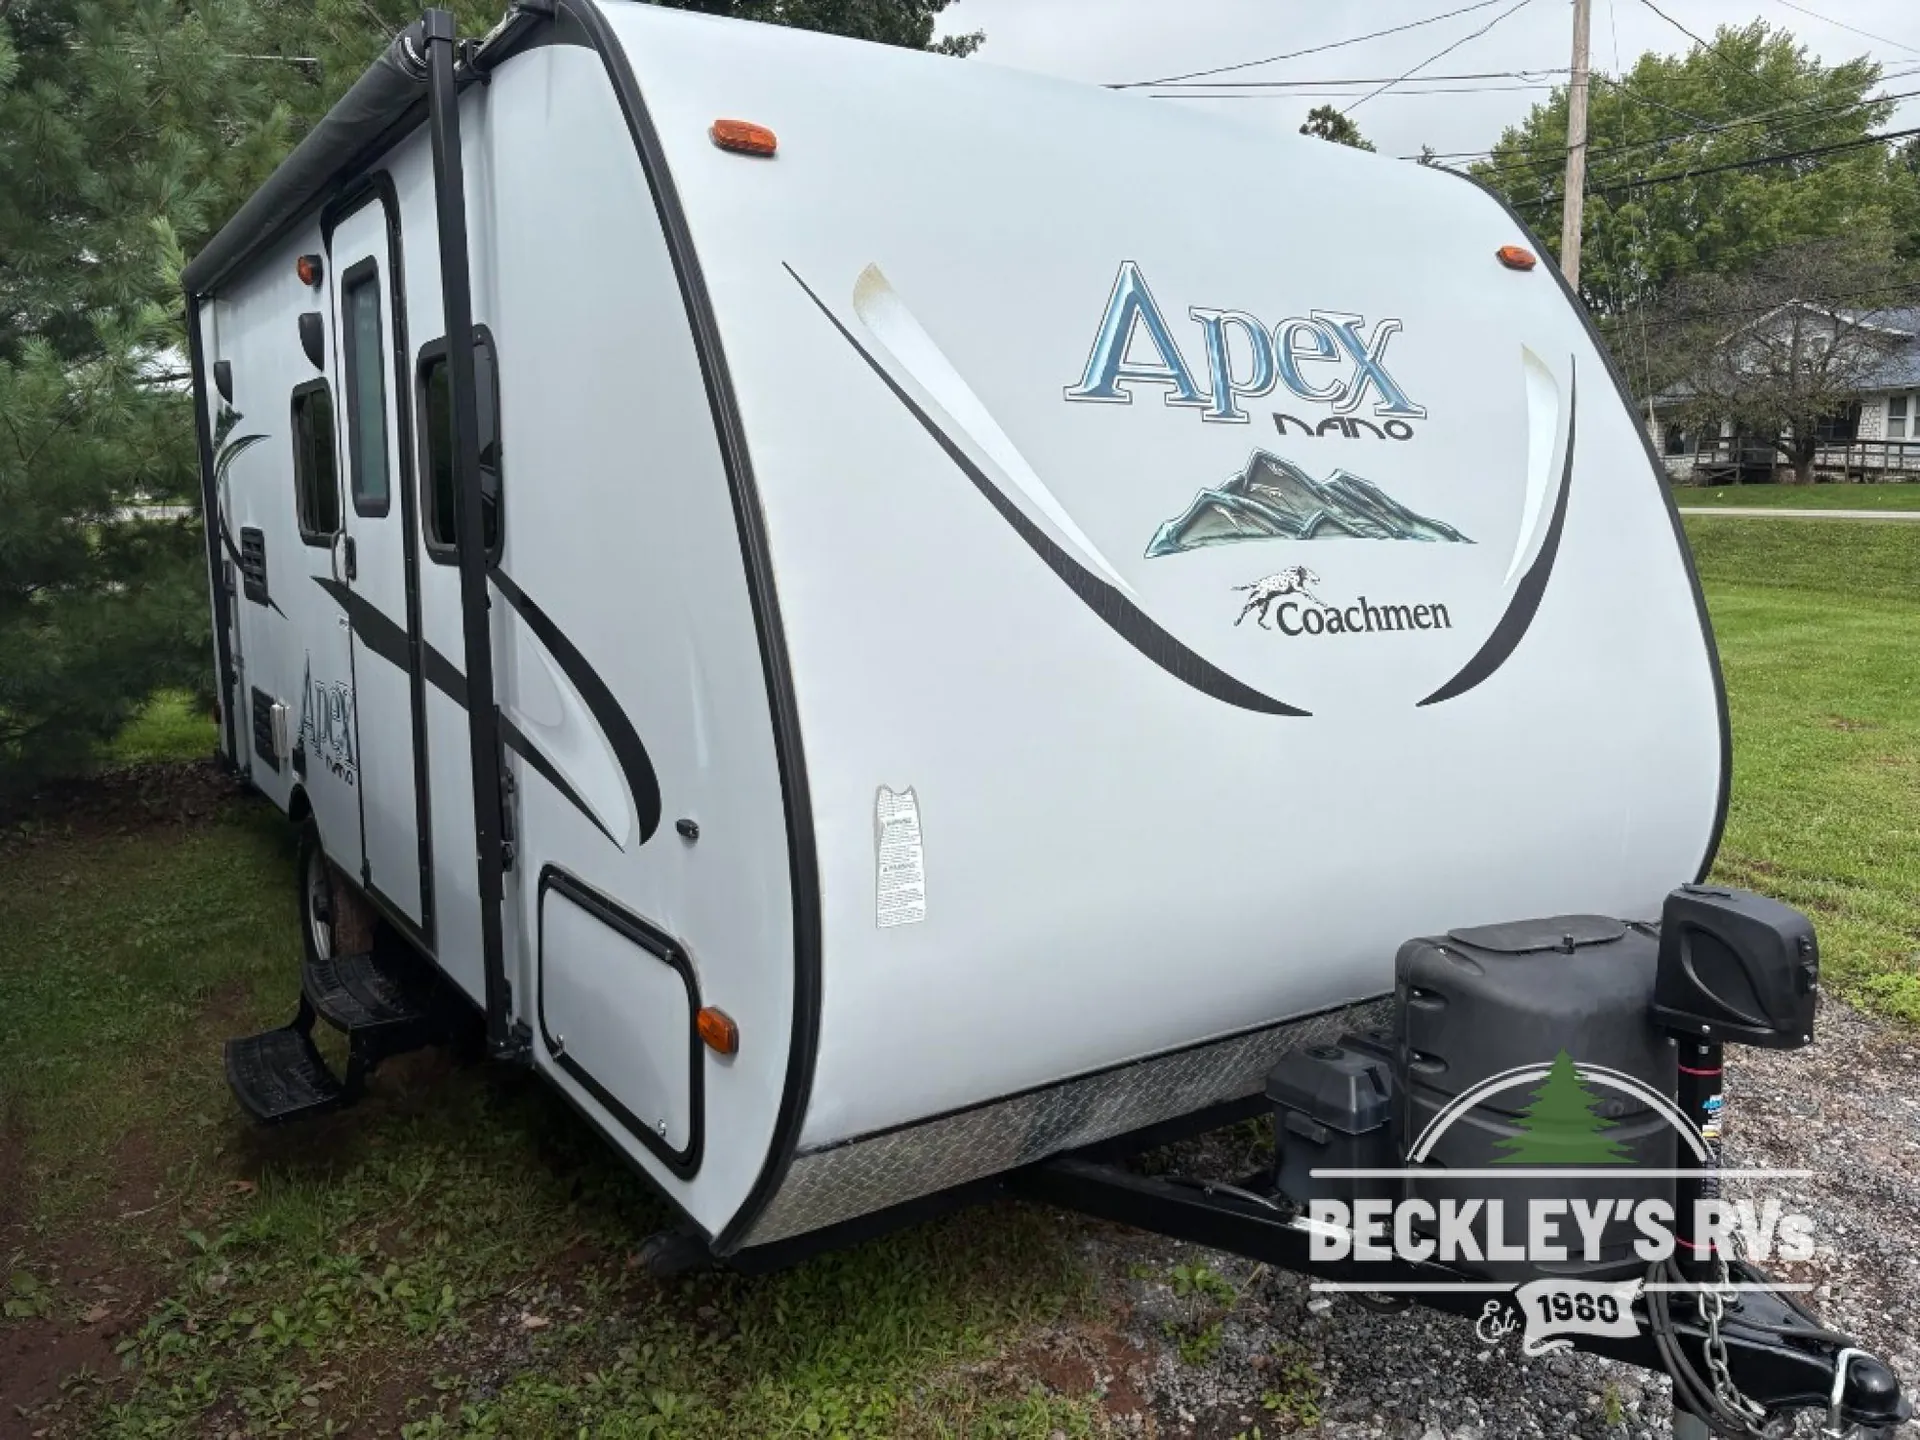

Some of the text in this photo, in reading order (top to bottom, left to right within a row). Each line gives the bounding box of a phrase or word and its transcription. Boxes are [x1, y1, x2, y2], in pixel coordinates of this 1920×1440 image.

[1063, 260, 1427, 424] Apex
[1276, 596, 1452, 637] Coachmen
[298, 648, 357, 771] Apex
